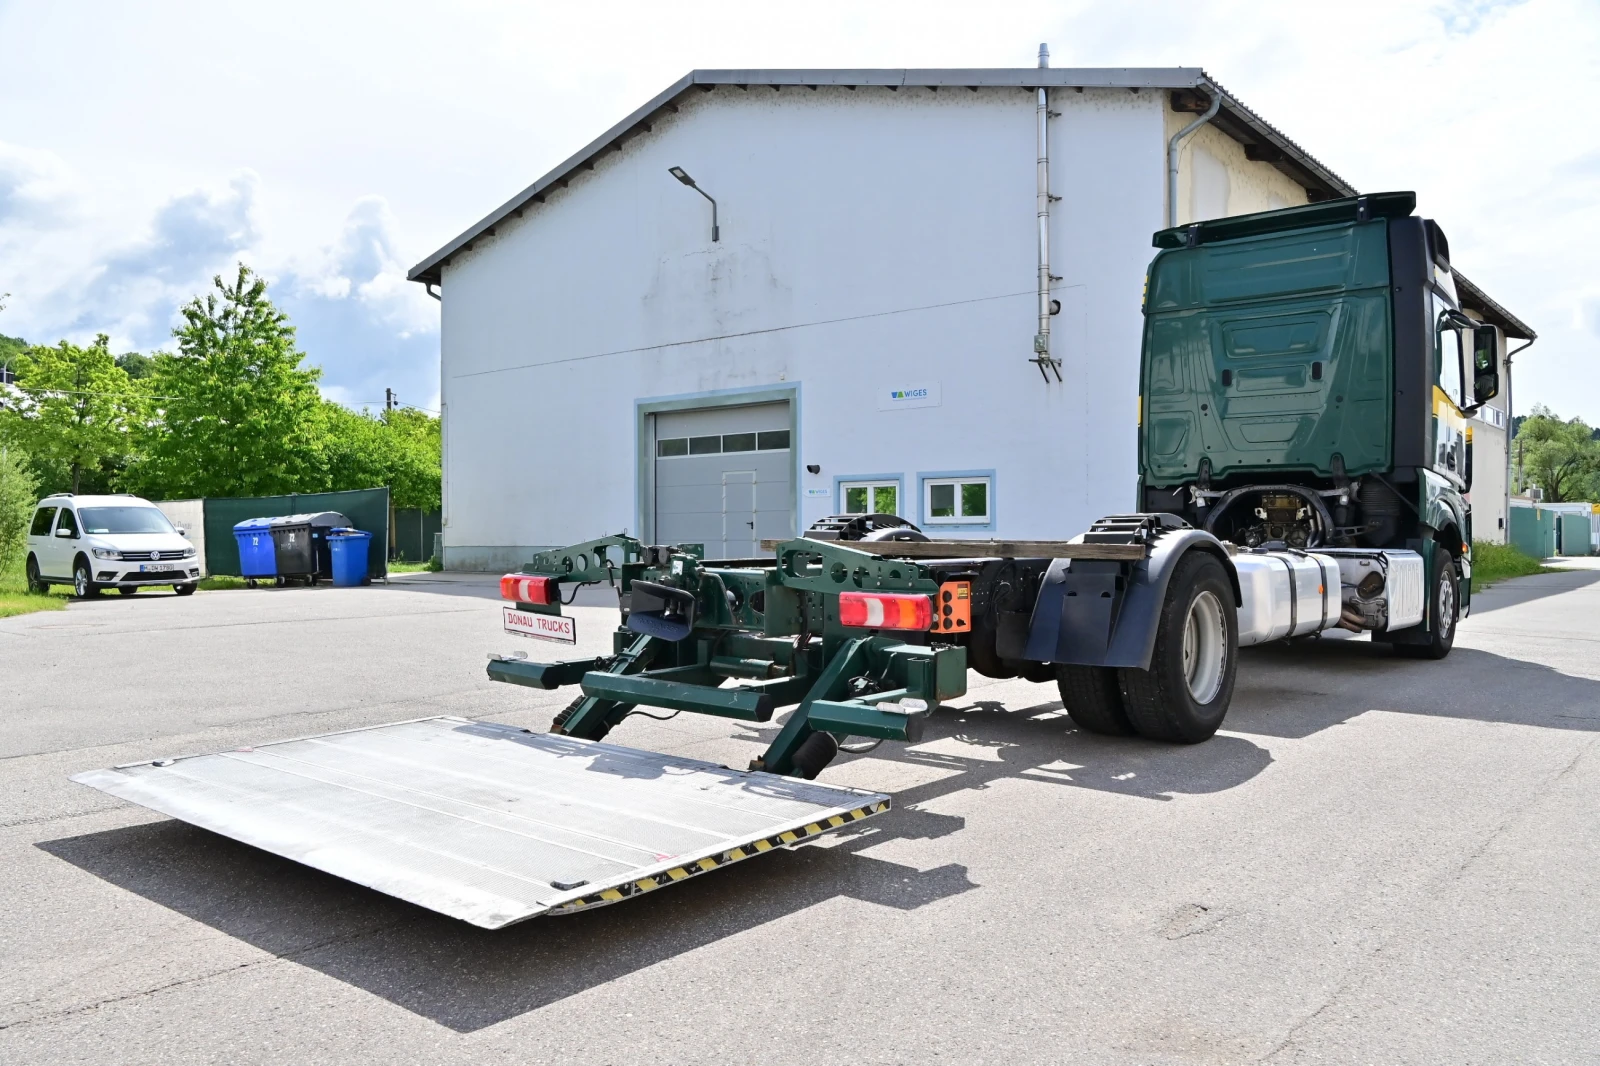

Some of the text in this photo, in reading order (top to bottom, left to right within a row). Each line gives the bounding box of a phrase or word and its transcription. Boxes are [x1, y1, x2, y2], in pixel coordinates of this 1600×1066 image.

[904, 389, 927, 397] WIGES
[252, 537, 259, 546] 72
[289, 533, 295, 543] 72
[507, 612, 570, 634] DONAU TRUCKS
